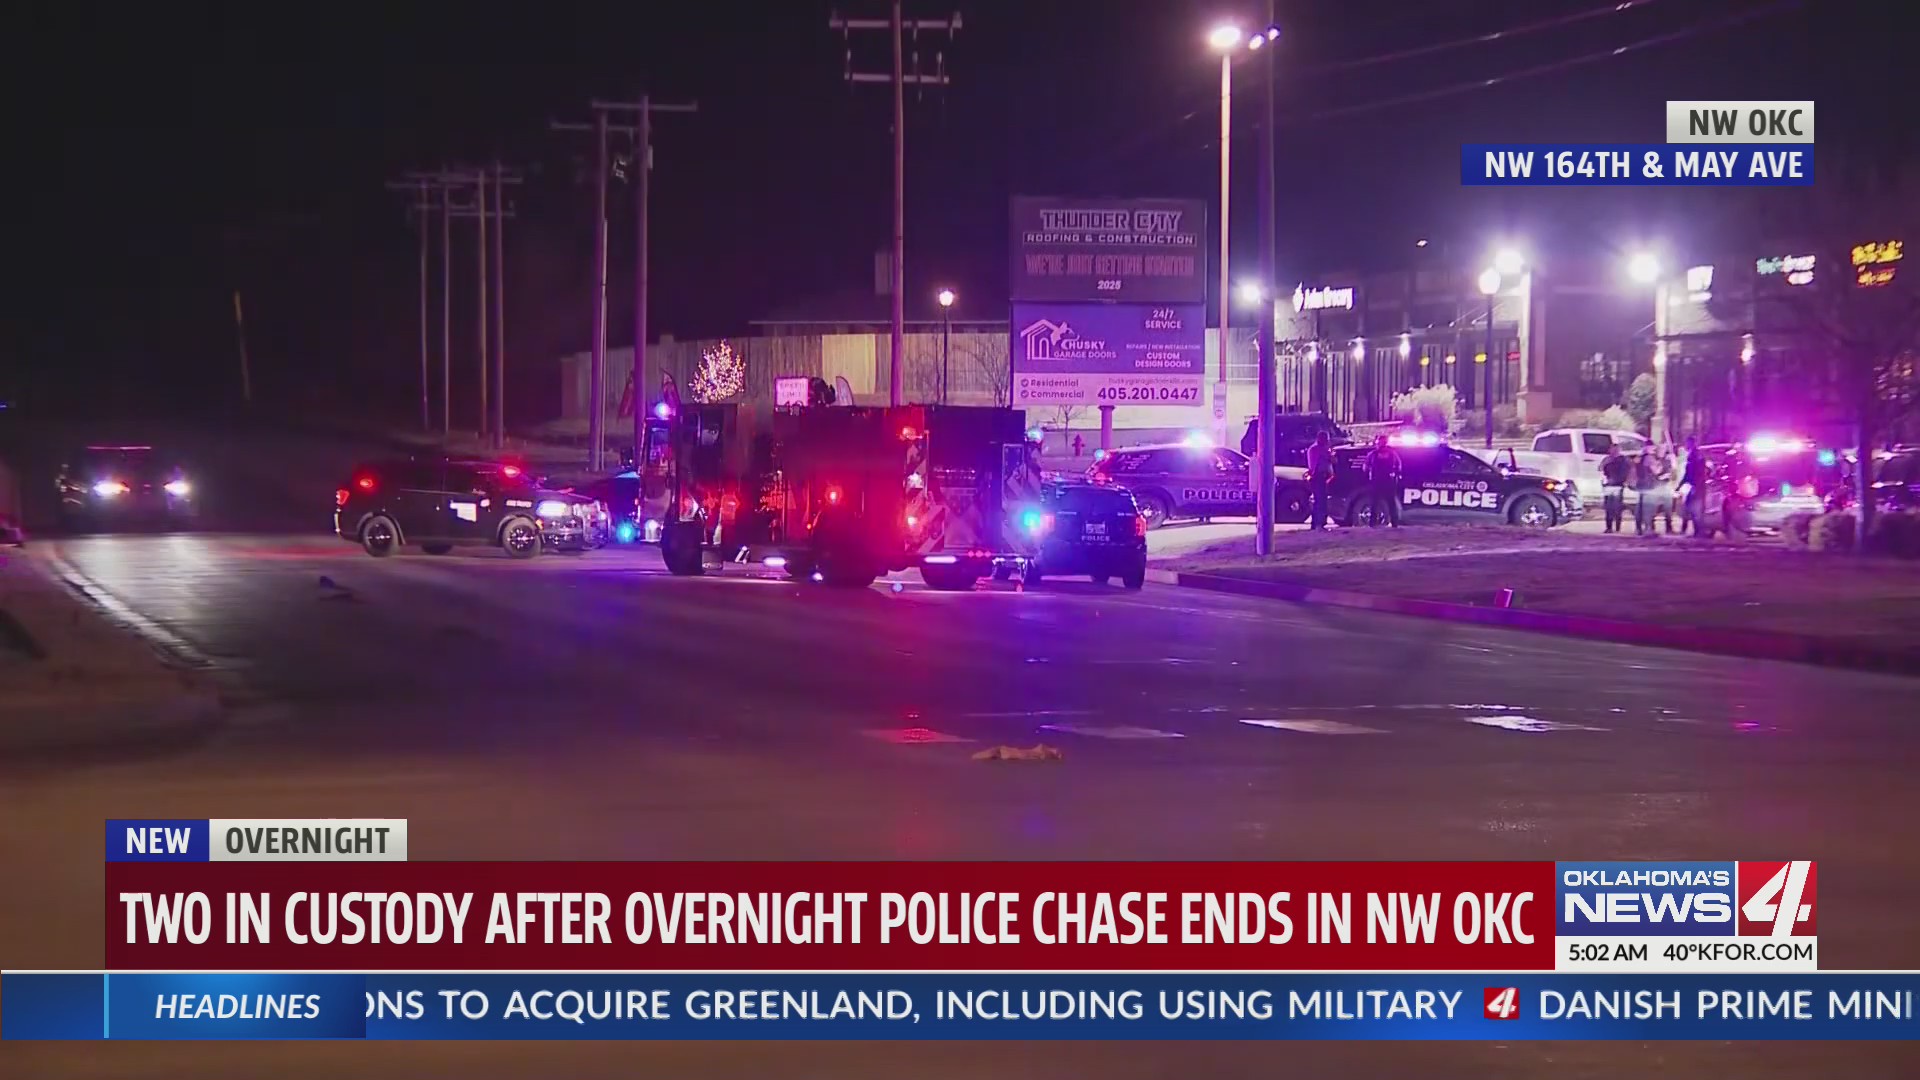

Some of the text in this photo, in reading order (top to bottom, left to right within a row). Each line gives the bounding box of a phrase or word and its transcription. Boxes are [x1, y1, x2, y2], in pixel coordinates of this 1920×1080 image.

[1040, 209, 1182, 233] THUNDER CITY
[1027, 234, 1193, 244] ROOFING & CONSTRUCTION
[1097, 280, 1122, 291] 2025
[1152, 308, 1174, 320] 24/7
[1145, 320, 1182, 329] SERVICE
[1054, 351, 1117, 359] GARAGE DOORS
[1146, 352, 1180, 360] CUSTOM
[1135, 360, 1191, 368] DESIGN DOORS
[1030, 378, 1079, 388] Residential
[1031, 390, 1085, 399] Commercial
[1097, 387, 1198, 400] 405.201.0447
[1183, 488, 1254, 502] POLICE
[1403, 488, 1497, 508] POLICE
